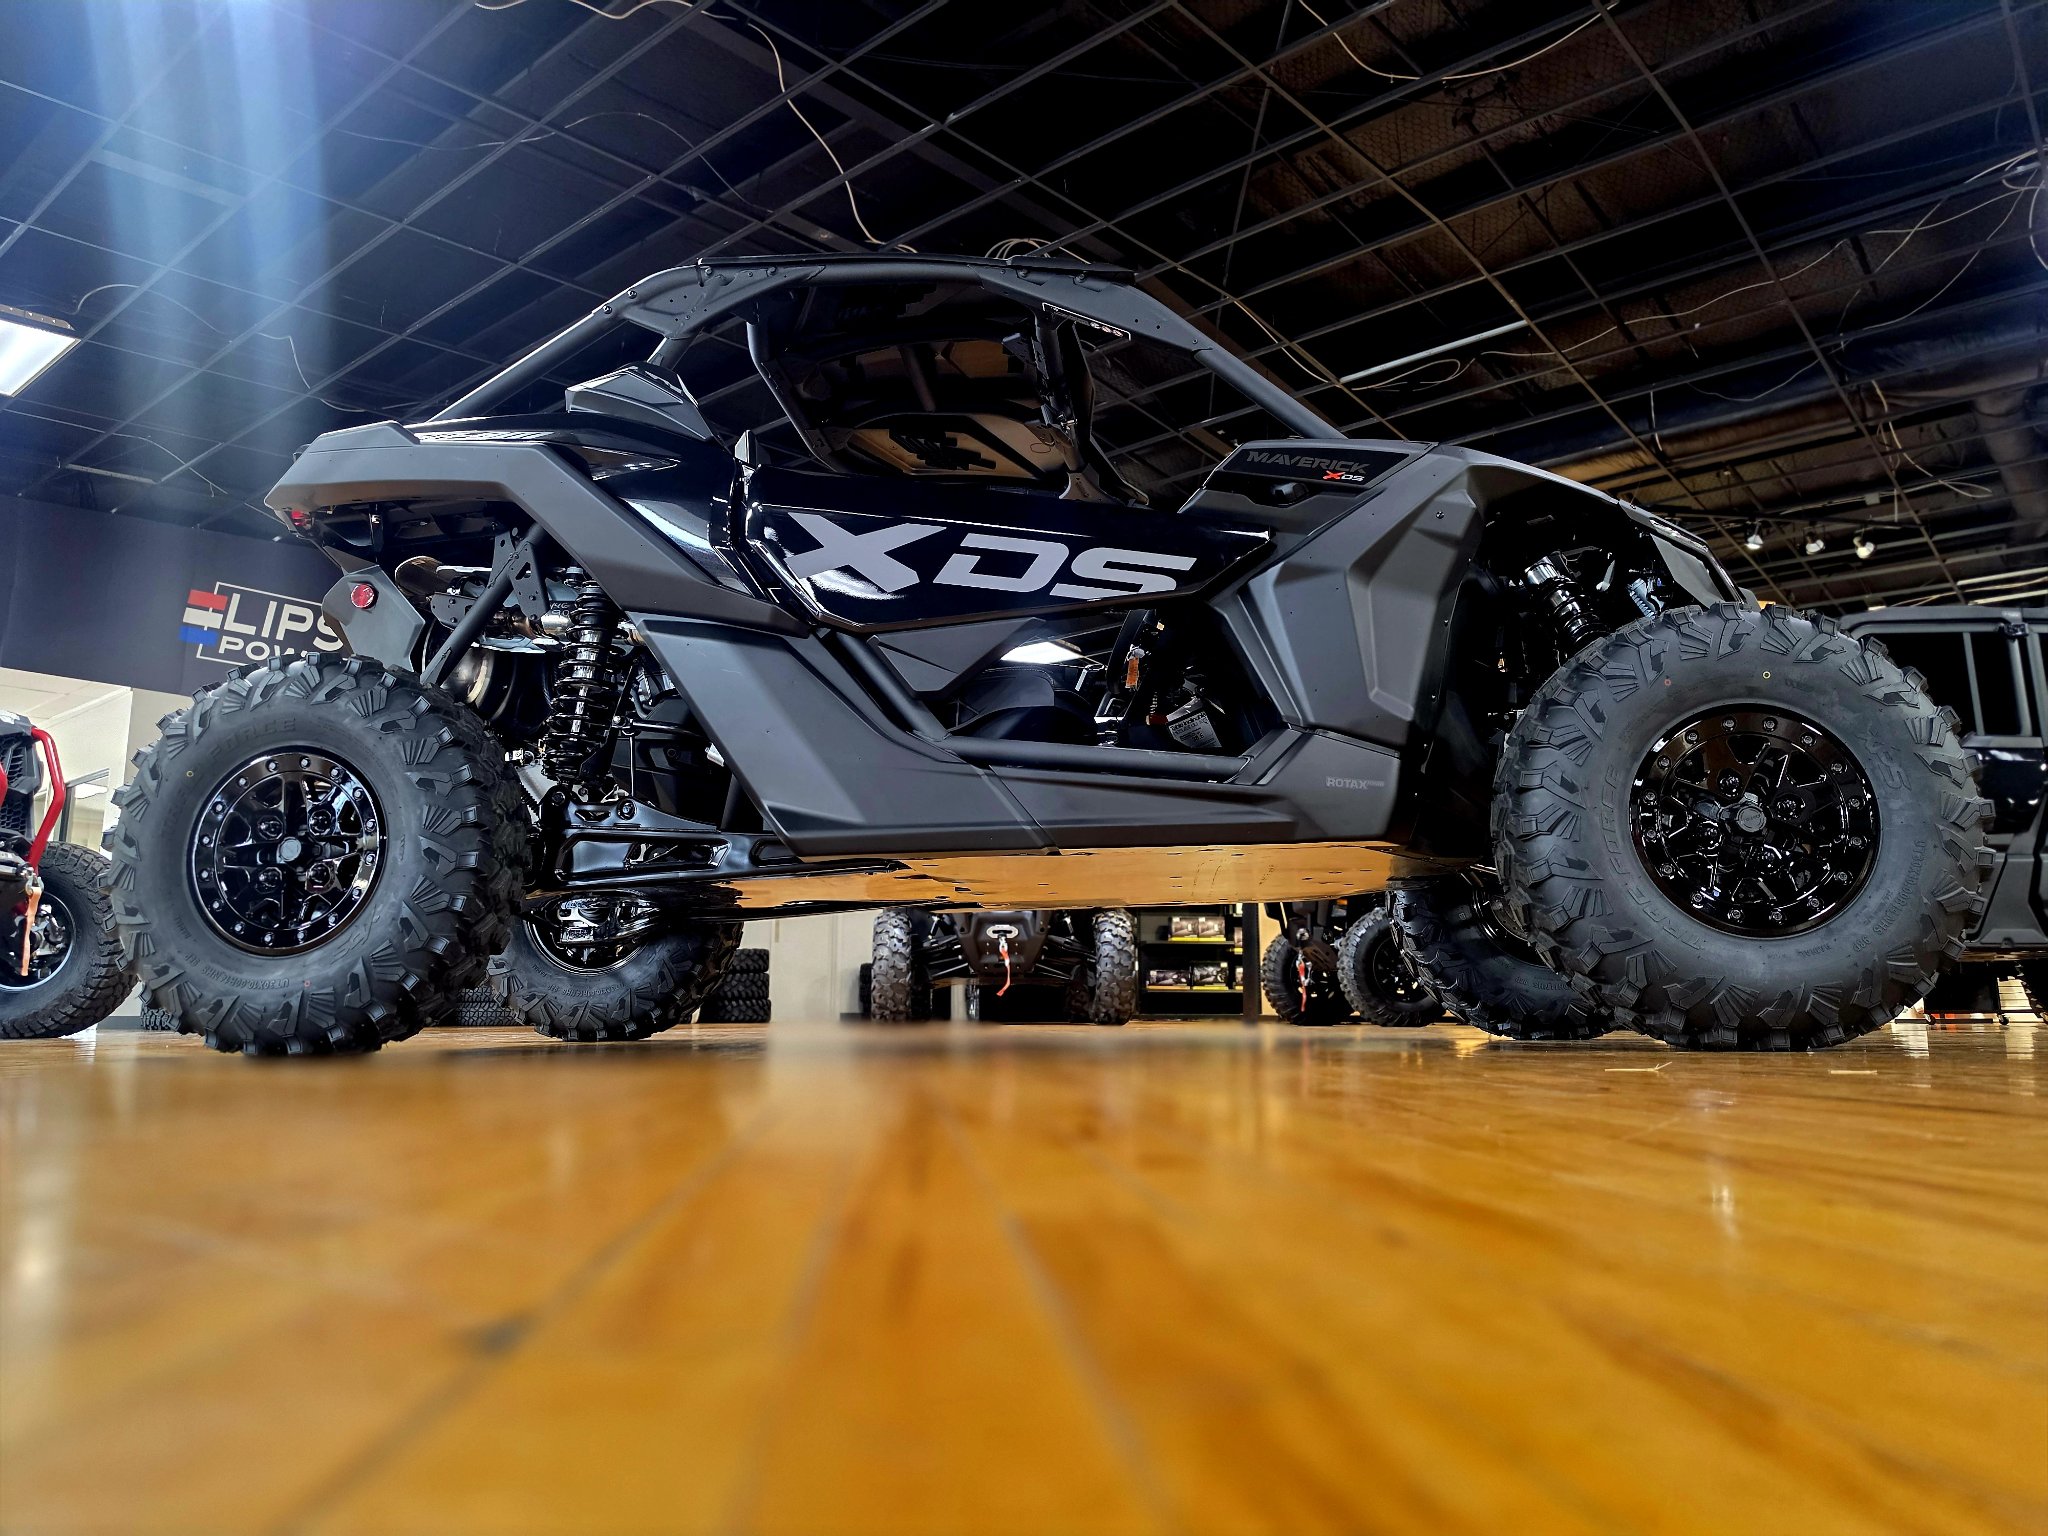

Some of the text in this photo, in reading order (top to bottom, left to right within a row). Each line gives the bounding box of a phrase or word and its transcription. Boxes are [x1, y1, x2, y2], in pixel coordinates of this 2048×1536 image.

[1247, 451, 1370, 475] MAVERICK
[1323, 470, 1365, 482] XDS
[784, 511, 1198, 600] XDS
[1325, 776, 1369, 790] ROTAX
[1601, 764, 1631, 875] FORCE
